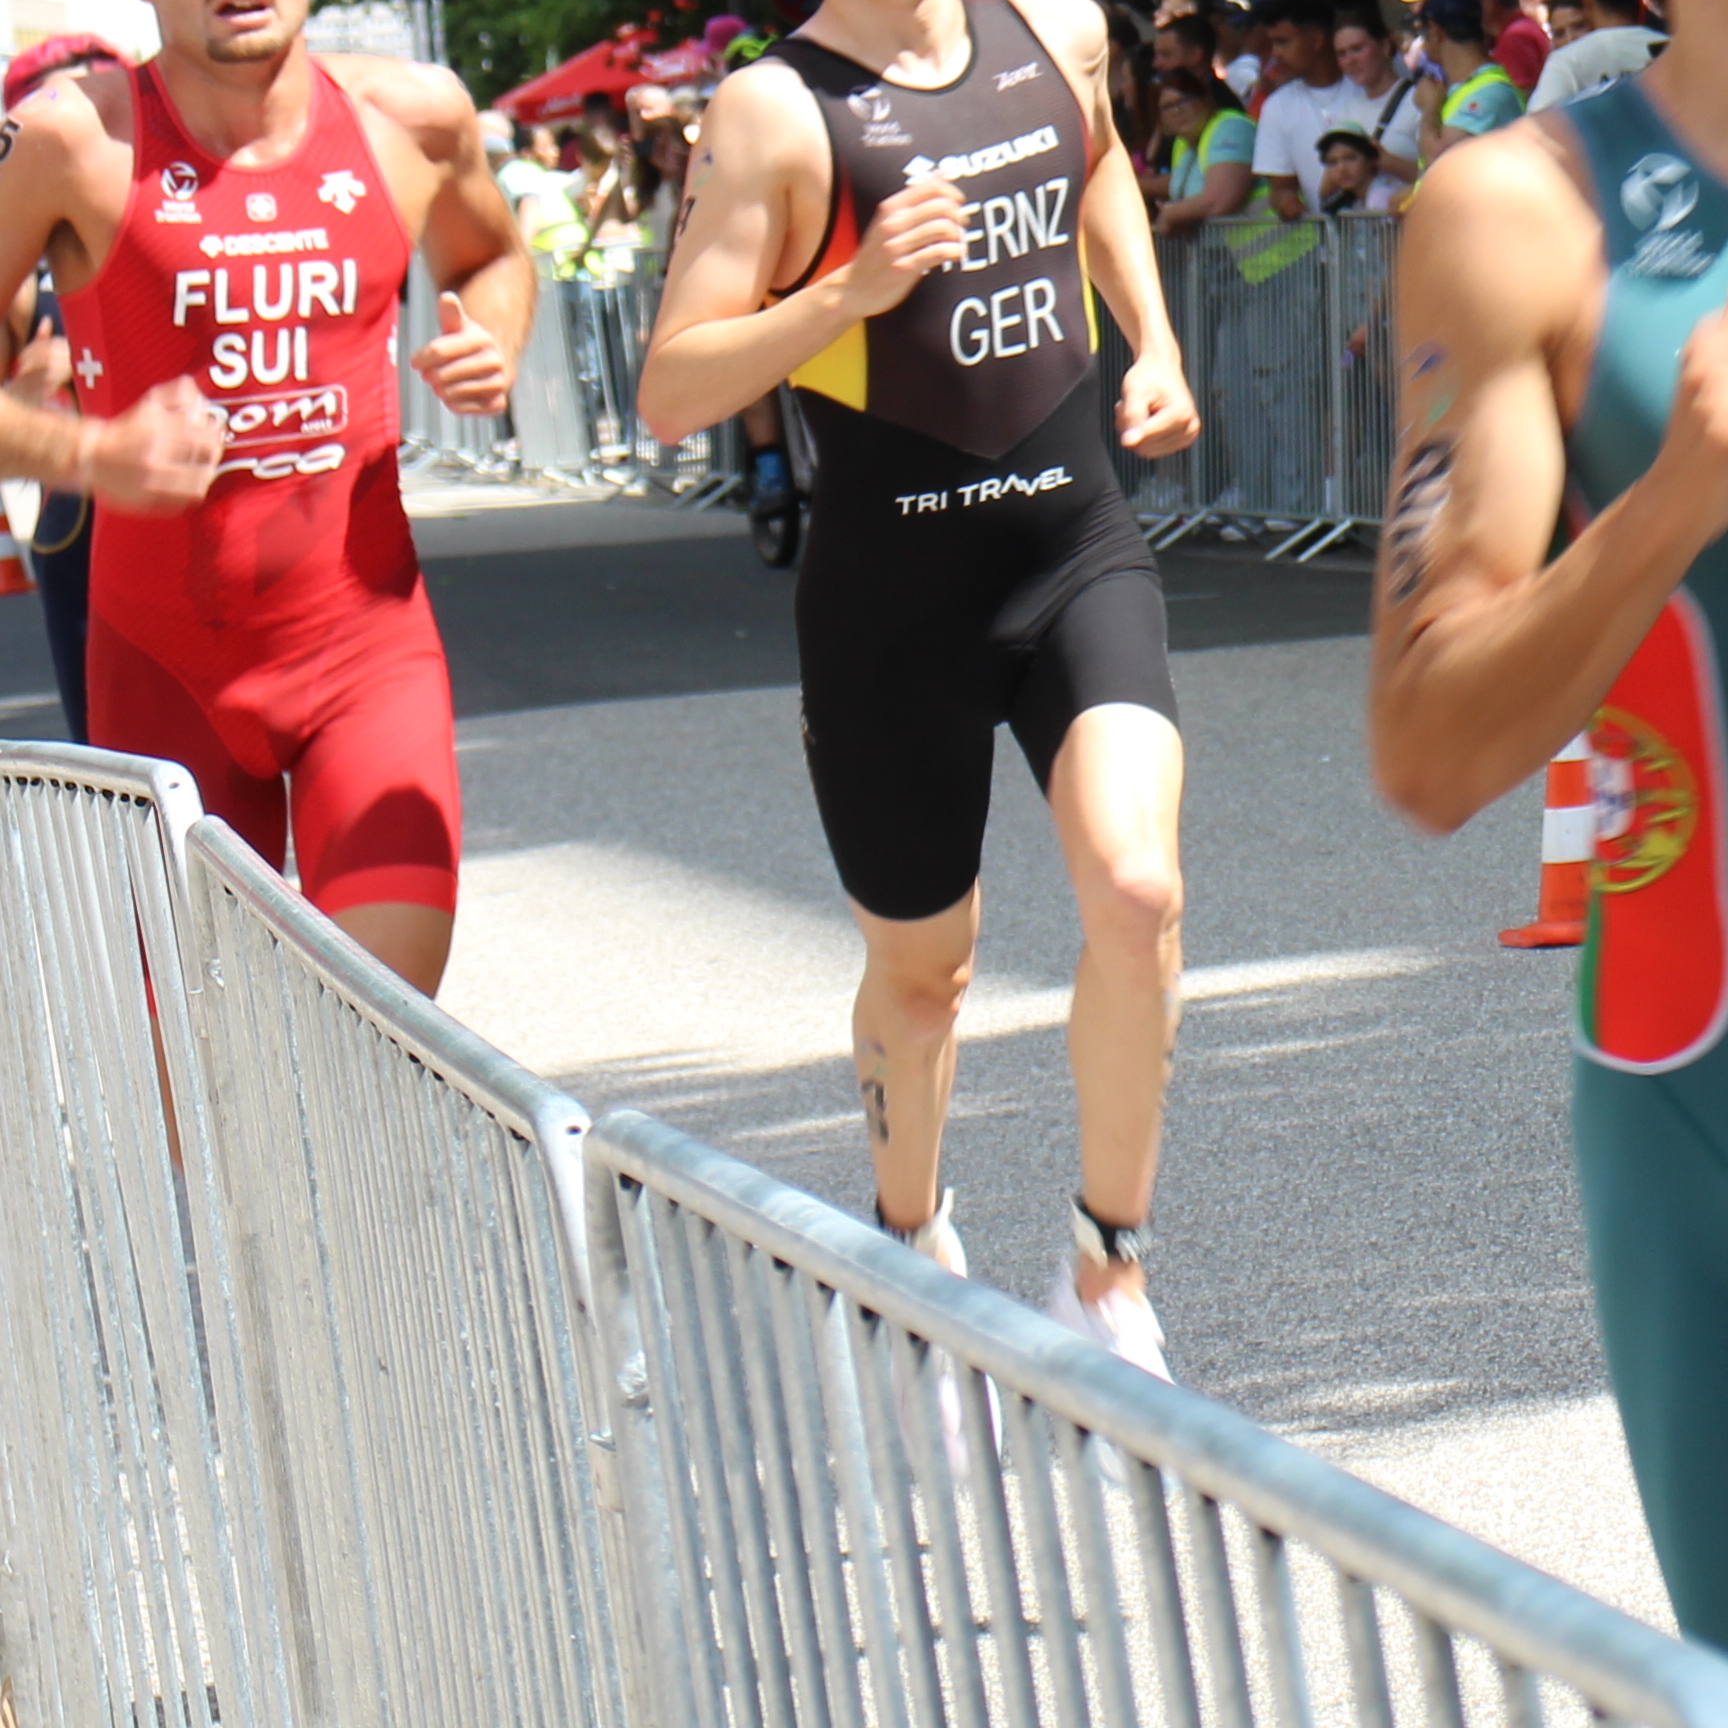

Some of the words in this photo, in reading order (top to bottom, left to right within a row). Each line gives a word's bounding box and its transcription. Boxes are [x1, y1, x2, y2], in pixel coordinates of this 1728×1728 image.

[937, 124, 1060, 180] SUZUKI
[223, 227, 330, 258] DESCENTE
[922, 176, 1069, 274] ERNZ
[173, 258, 358, 328] FLURI
[950, 276, 1065, 368] GER
[208, 325, 308, 390] SUI
[215, 442, 347, 480] rca
[895, 490, 948, 516] TRI
[956, 465, 1074, 508] TRAVEL
